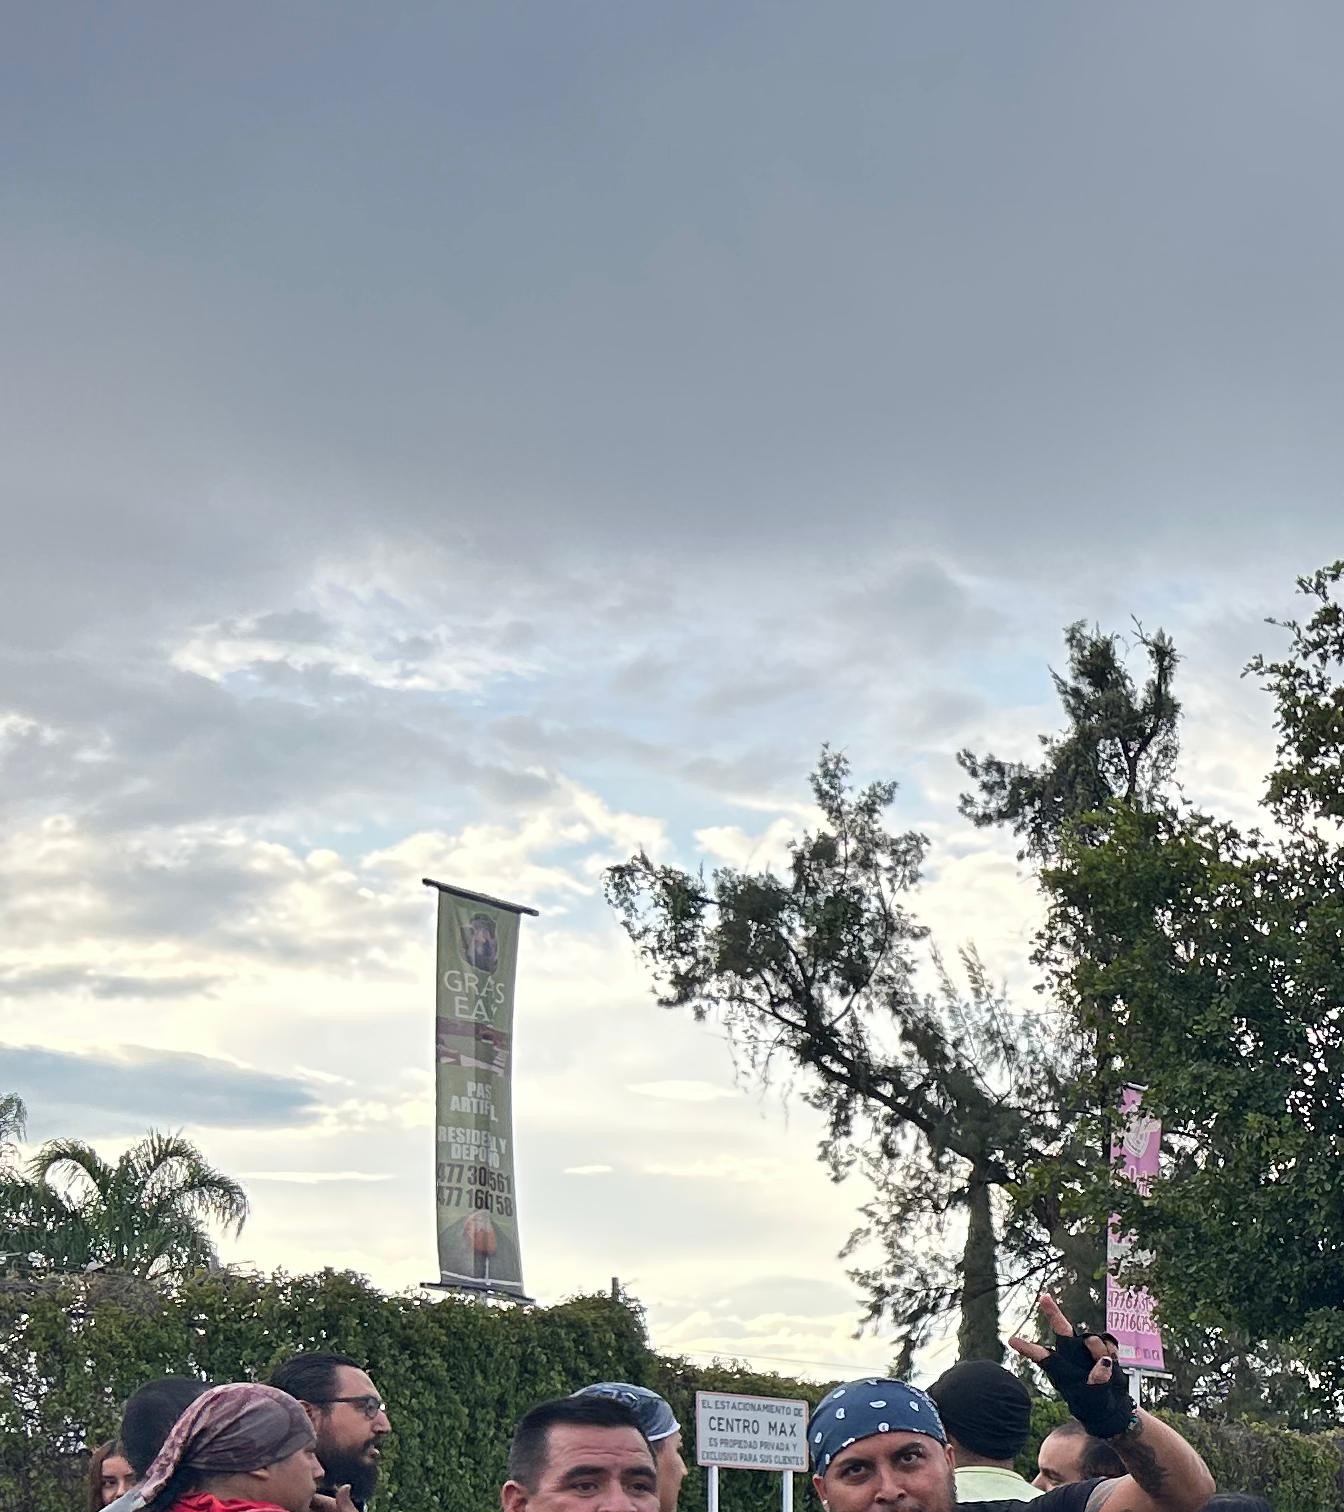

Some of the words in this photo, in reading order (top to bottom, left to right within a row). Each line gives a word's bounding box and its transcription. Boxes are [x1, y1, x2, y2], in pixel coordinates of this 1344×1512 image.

[701, 1400, 712, 1409] EL
[793, 1407, 804, 1418] DE
[708, 1416, 760, 1435] CENTRO
[768, 1421, 797, 1438] MAX
[759, 1440, 790, 1452] PRIVADA
[739, 1453, 759, 1463] PARA
